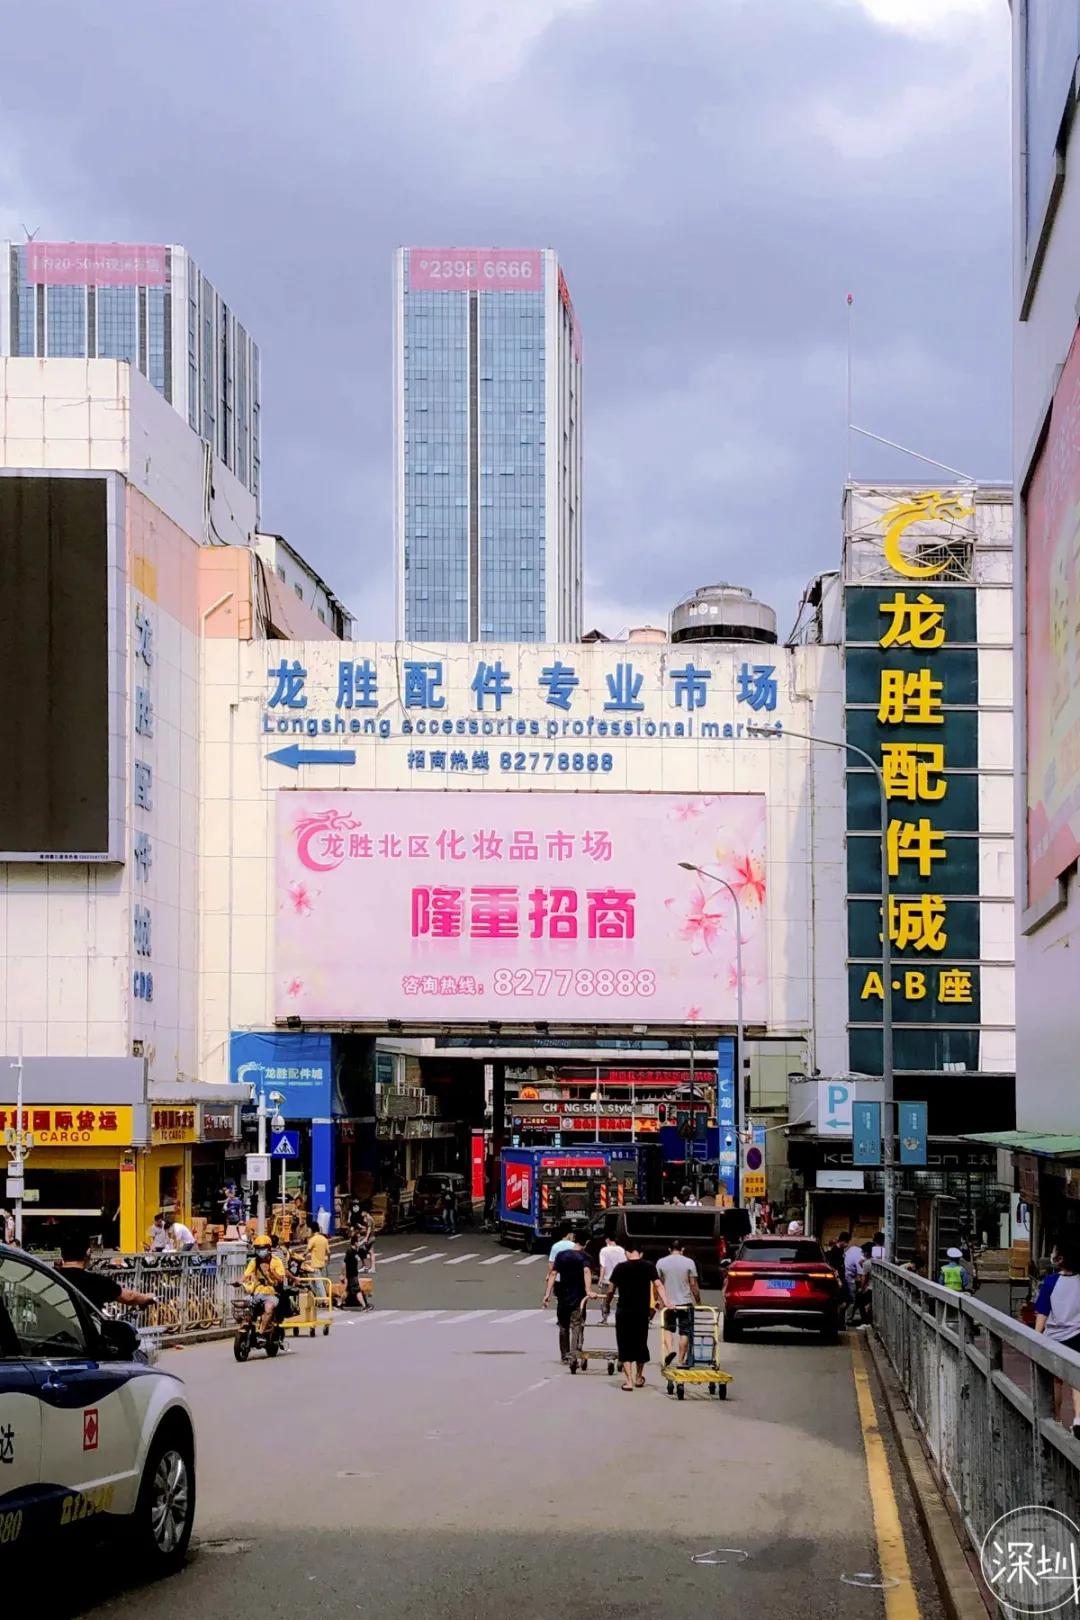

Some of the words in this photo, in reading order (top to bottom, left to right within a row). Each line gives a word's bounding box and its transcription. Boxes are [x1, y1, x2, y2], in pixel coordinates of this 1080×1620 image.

[484, 260, 532, 278] 6666
[267, 658, 778, 712] 龙胜配件专业市场
[263, 713, 391, 737] Longsheng
[401, 715, 540, 736] accessories
[547, 716, 693, 738] professional
[500, 751, 613, 771] 82778888
[877, 592, 947, 951] 龙胜配件城
[320, 829, 613, 862] 龙胜北区化妆品市场
[411, 886, 636, 939] 隆重招商
[493, 968, 656, 997] 82778888
[828, 1085, 849, 1114] P
[40, 1131, 91, 1142] CARGO
